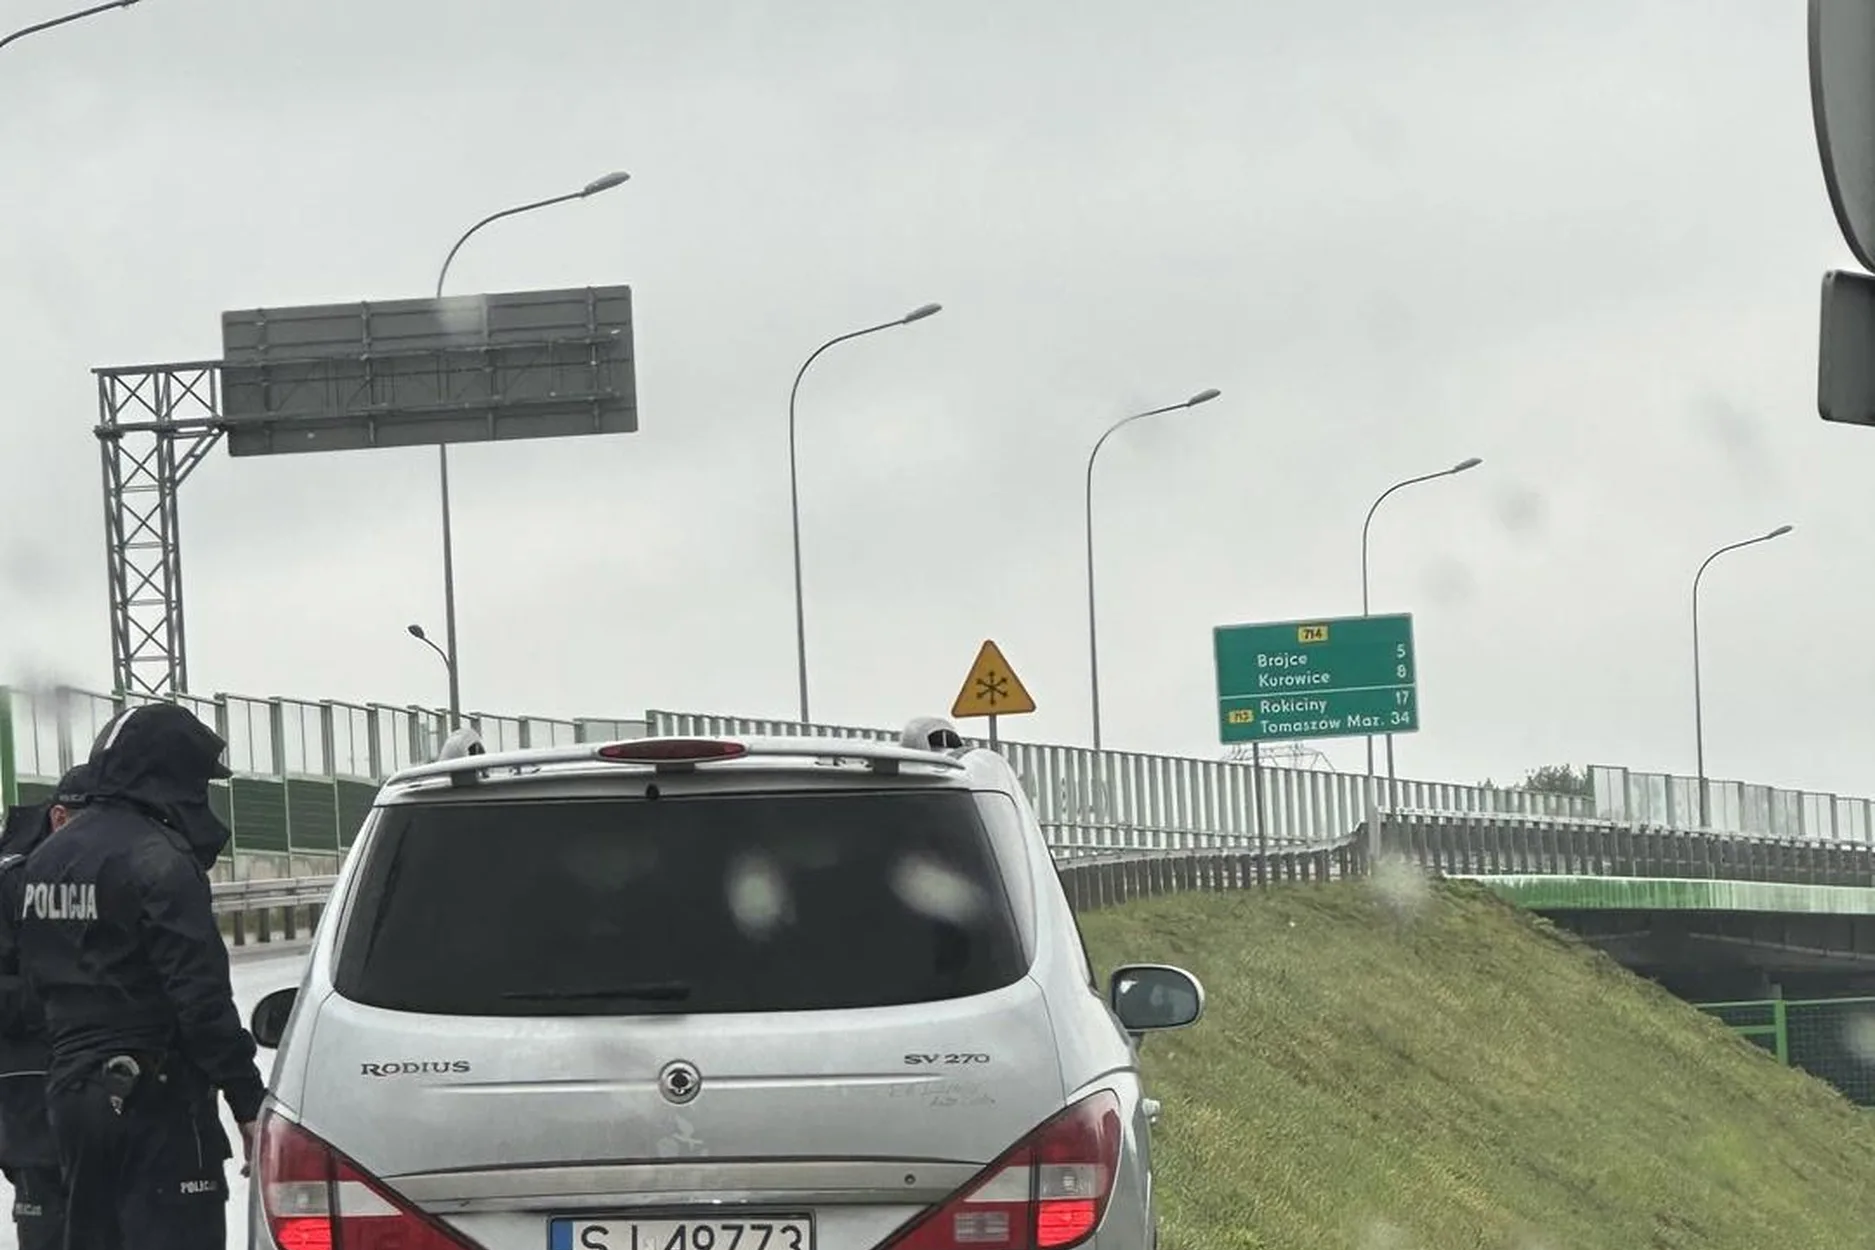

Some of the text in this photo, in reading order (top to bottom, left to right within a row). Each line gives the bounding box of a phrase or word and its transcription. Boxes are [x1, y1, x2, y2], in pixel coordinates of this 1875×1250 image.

[1396, 643, 1406, 658] 5
[1258, 664, 1406, 687] Kurowice 8
[1260, 690, 1409, 714] Rokiciny 17
[1390, 711, 1410, 725] 34
[22, 882, 98, 919] POLICJA
[904, 1053, 991, 1065] SV 270
[360, 1060, 471, 1077] RODIUS
